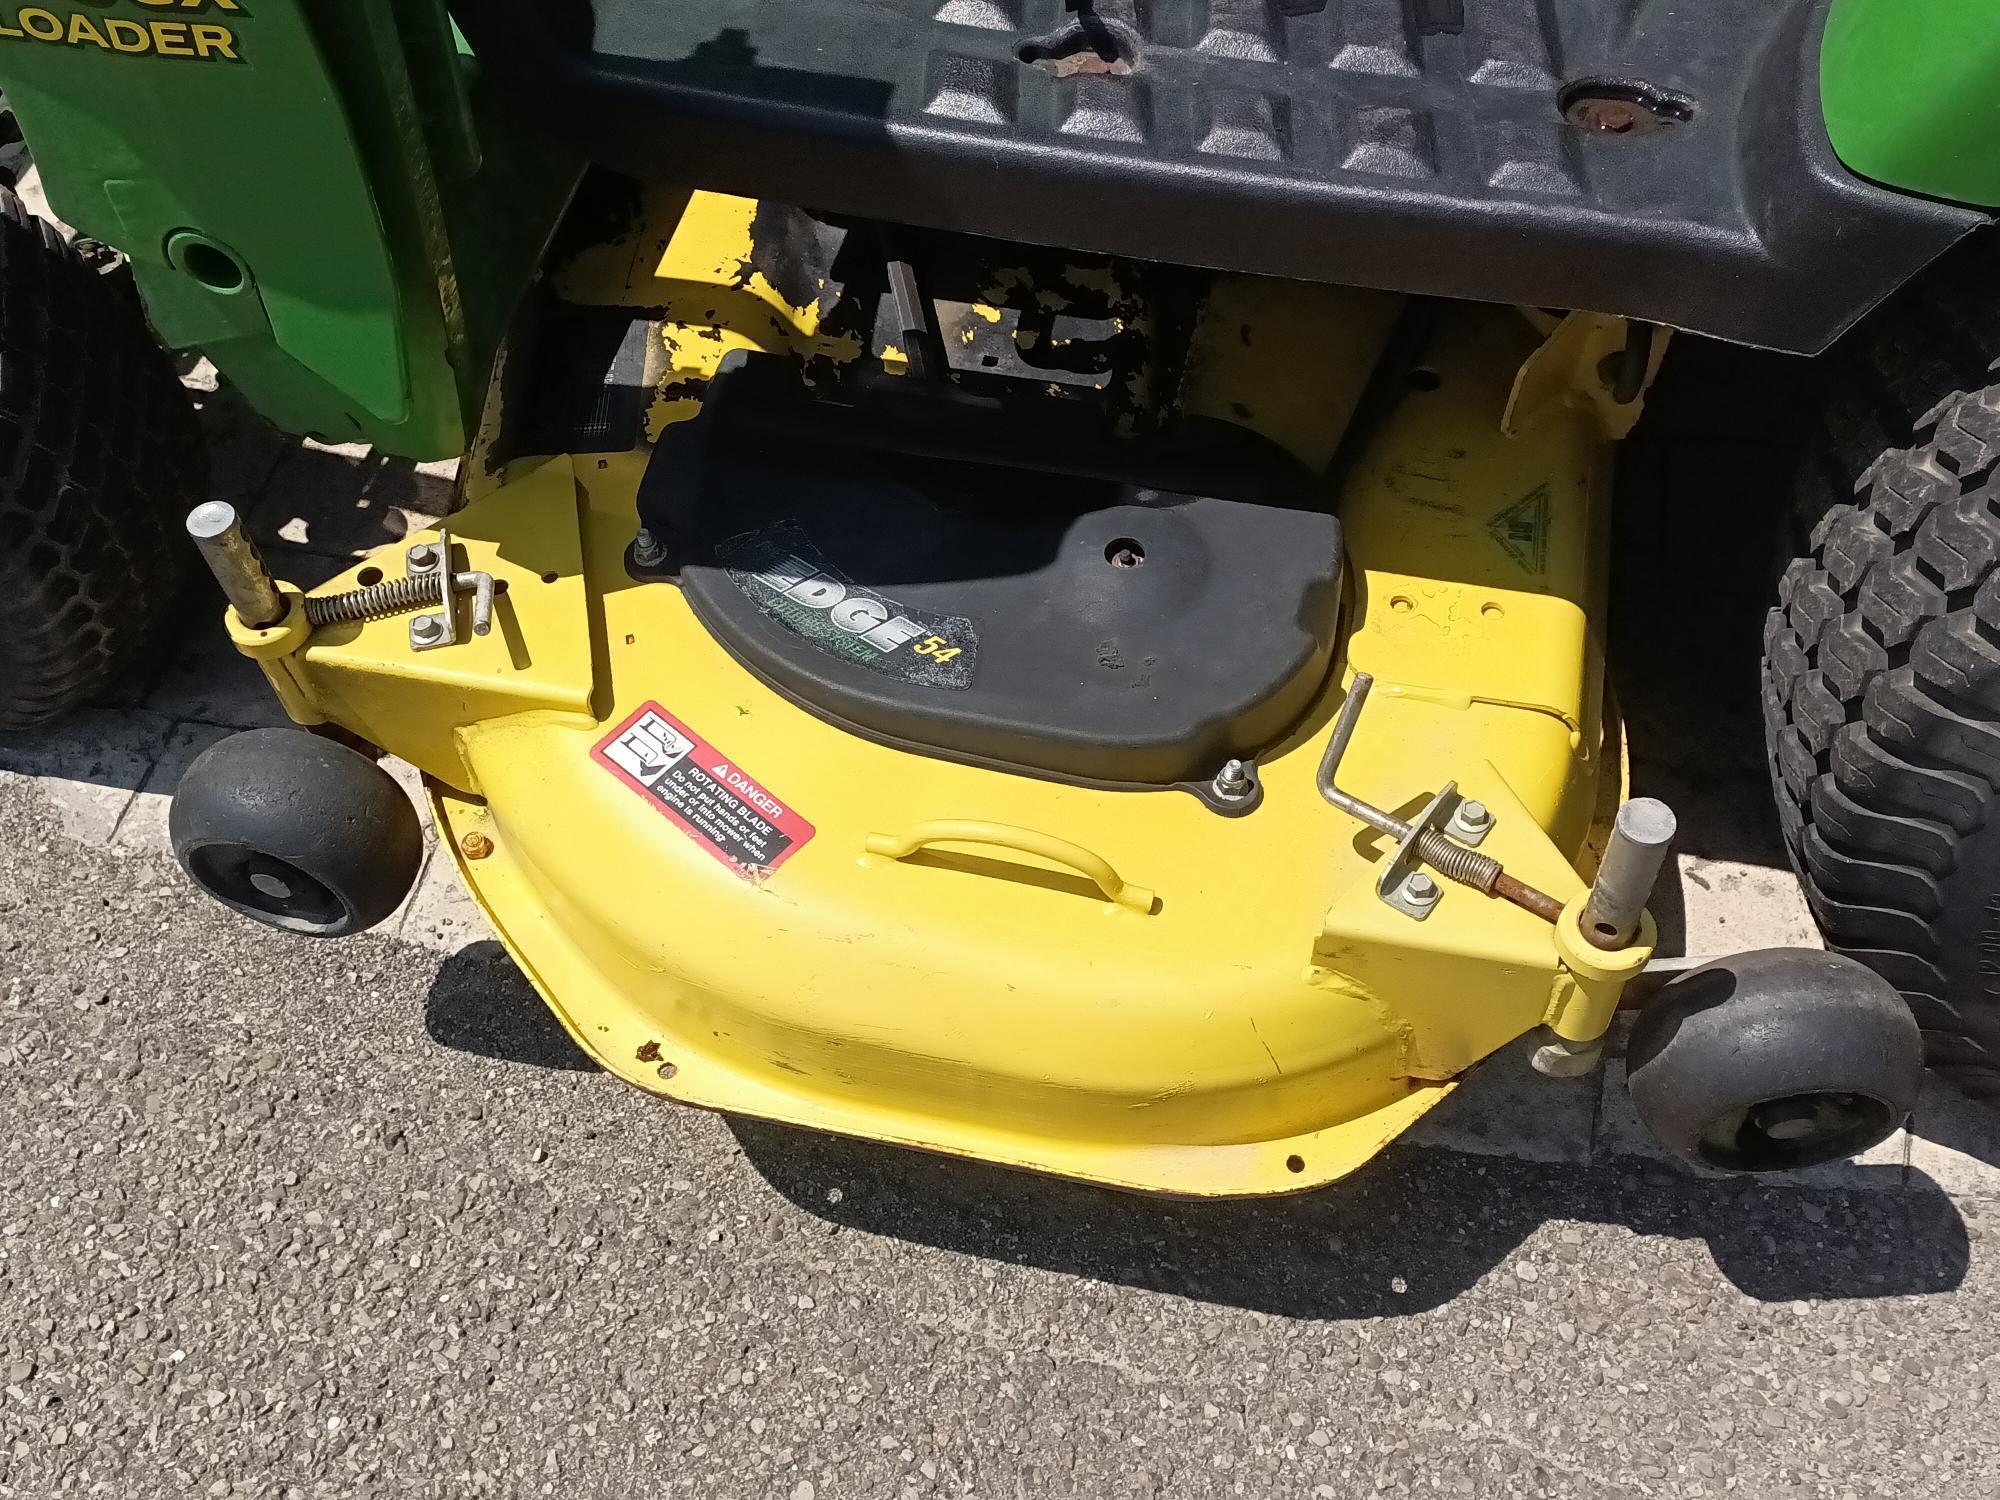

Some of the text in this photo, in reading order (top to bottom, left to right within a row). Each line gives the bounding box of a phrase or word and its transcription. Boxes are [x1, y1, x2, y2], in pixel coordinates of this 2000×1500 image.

[752, 553, 927, 653] EDGE
[913, 635, 962, 664] 54
[656, 785, 684, 809] engine
[684, 805, 694, 816] is
[664, 778, 766, 861] under or into mower when
[672, 770, 767, 848] Do not put hands or feet
[688, 767, 773, 836] ROTATING BLADE
[727, 772, 783, 819] DANGER
